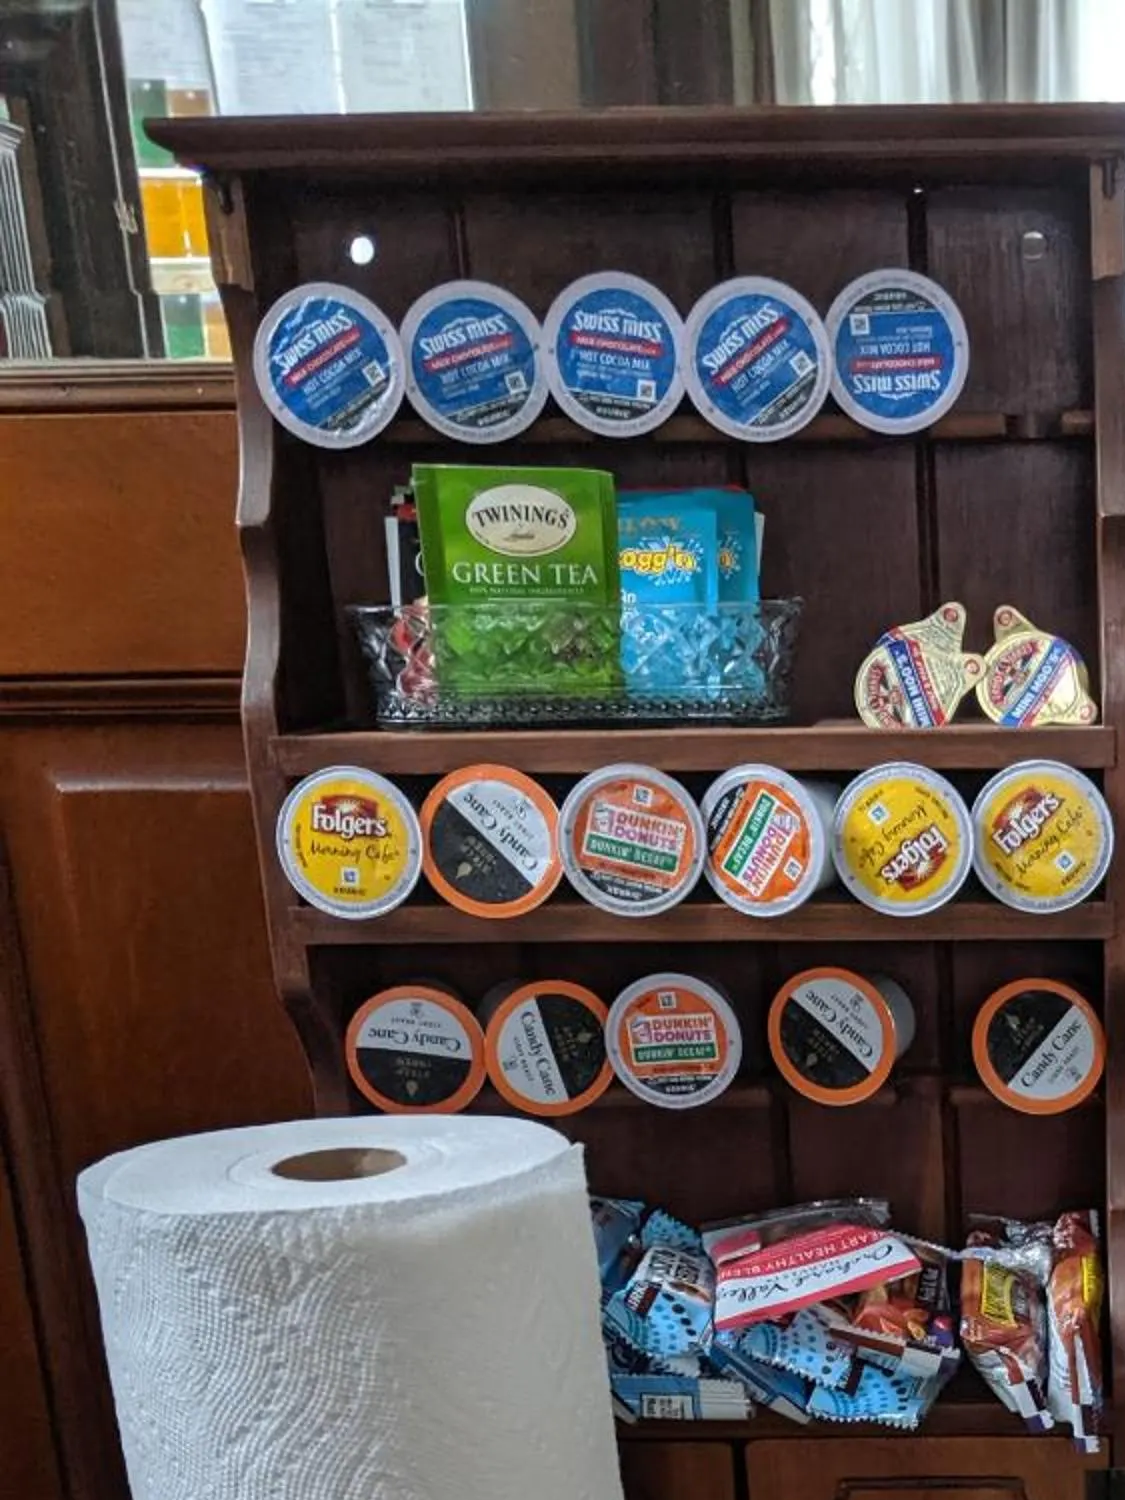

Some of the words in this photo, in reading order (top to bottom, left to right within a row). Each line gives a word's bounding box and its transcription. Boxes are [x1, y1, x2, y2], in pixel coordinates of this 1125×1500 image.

[473, 503, 570, 529] TWININGS
[452, 561, 540, 585] GREEN
[548, 563, 599, 585] TEA
[310, 803, 391, 841] Folgers
[463, 792, 497, 830] Cane
[991, 791, 1062, 857] Folgers
[499, 825, 538, 870] Candy
[879, 825, 949, 885] Folgers
[805, 990, 837, 1023] Cane
[367, 1027, 409, 1043] Cane
[412, 1033, 461, 1052] Candy
[521, 1011, 543, 1057] Candy
[535, 1057, 556, 1096] Cane
[835, 1017, 873, 1058] Candy
[1021, 1050, 1058, 1088] Candy
[1052, 1019, 1083, 1051] Cane
[766, 1246, 837, 1269] HEALTHY
